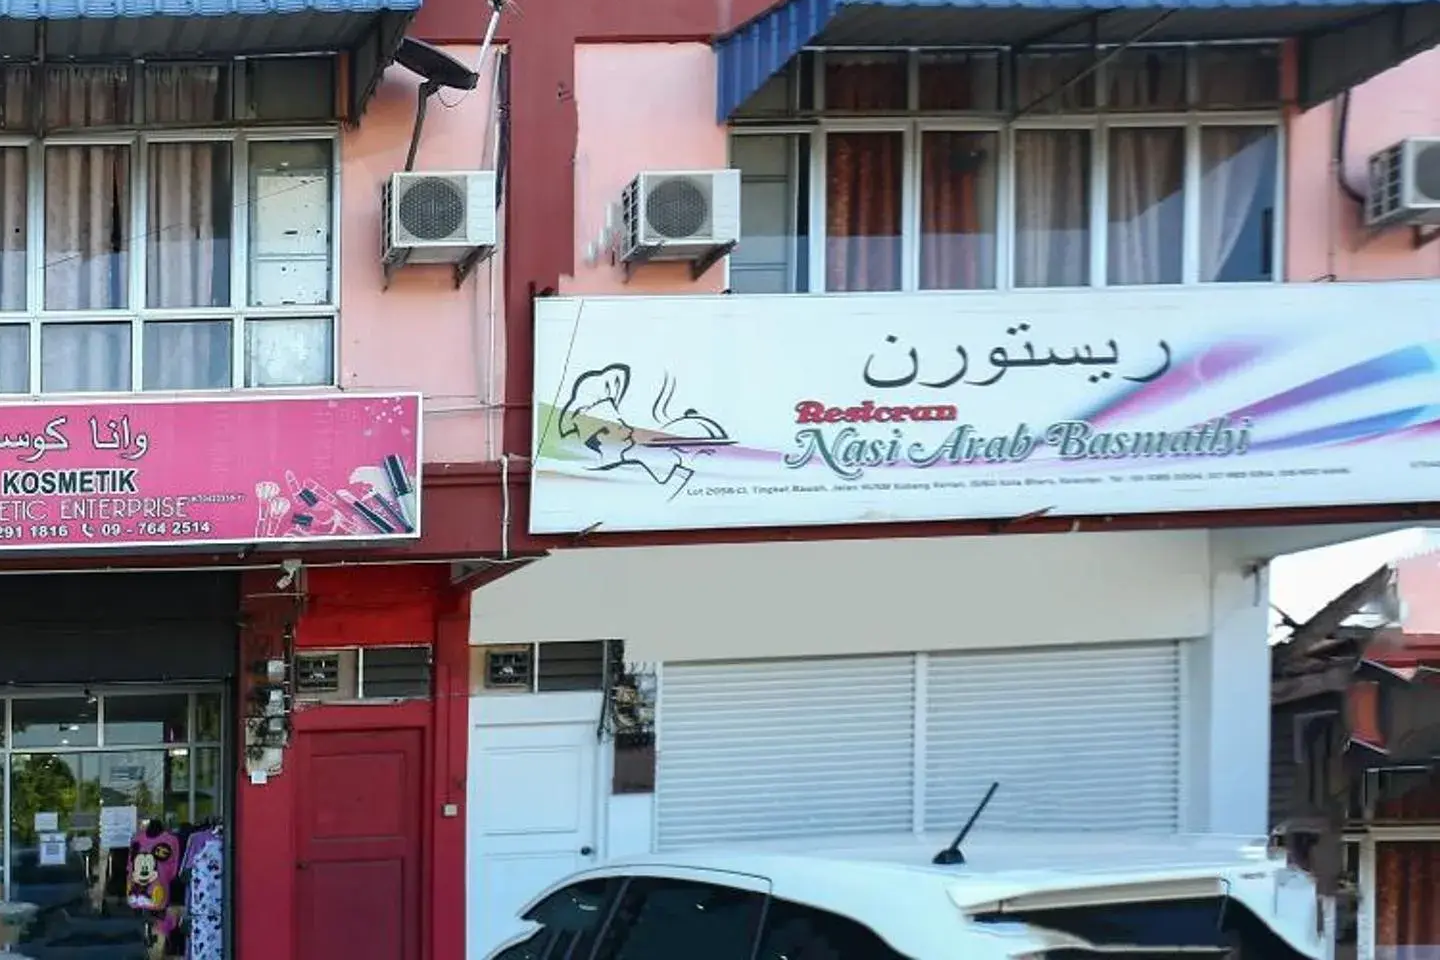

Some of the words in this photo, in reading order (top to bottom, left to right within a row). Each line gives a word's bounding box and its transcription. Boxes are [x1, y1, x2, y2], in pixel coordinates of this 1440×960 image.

[88, 415, 150, 461] وانا
[784, 426, 904, 480] Nasi
[908, 422, 1039, 469] Arab
[1045, 416, 1255, 461] Basmathi
[1, 467, 139, 496] KOSMETIK
[59, 496, 189, 521] ENTERPRISE
[29, 524, 69, 538] 1816
[101, 523, 121, 536] 09
[138, 523, 166, 536] 764
[171, 521, 211, 535] 2514
